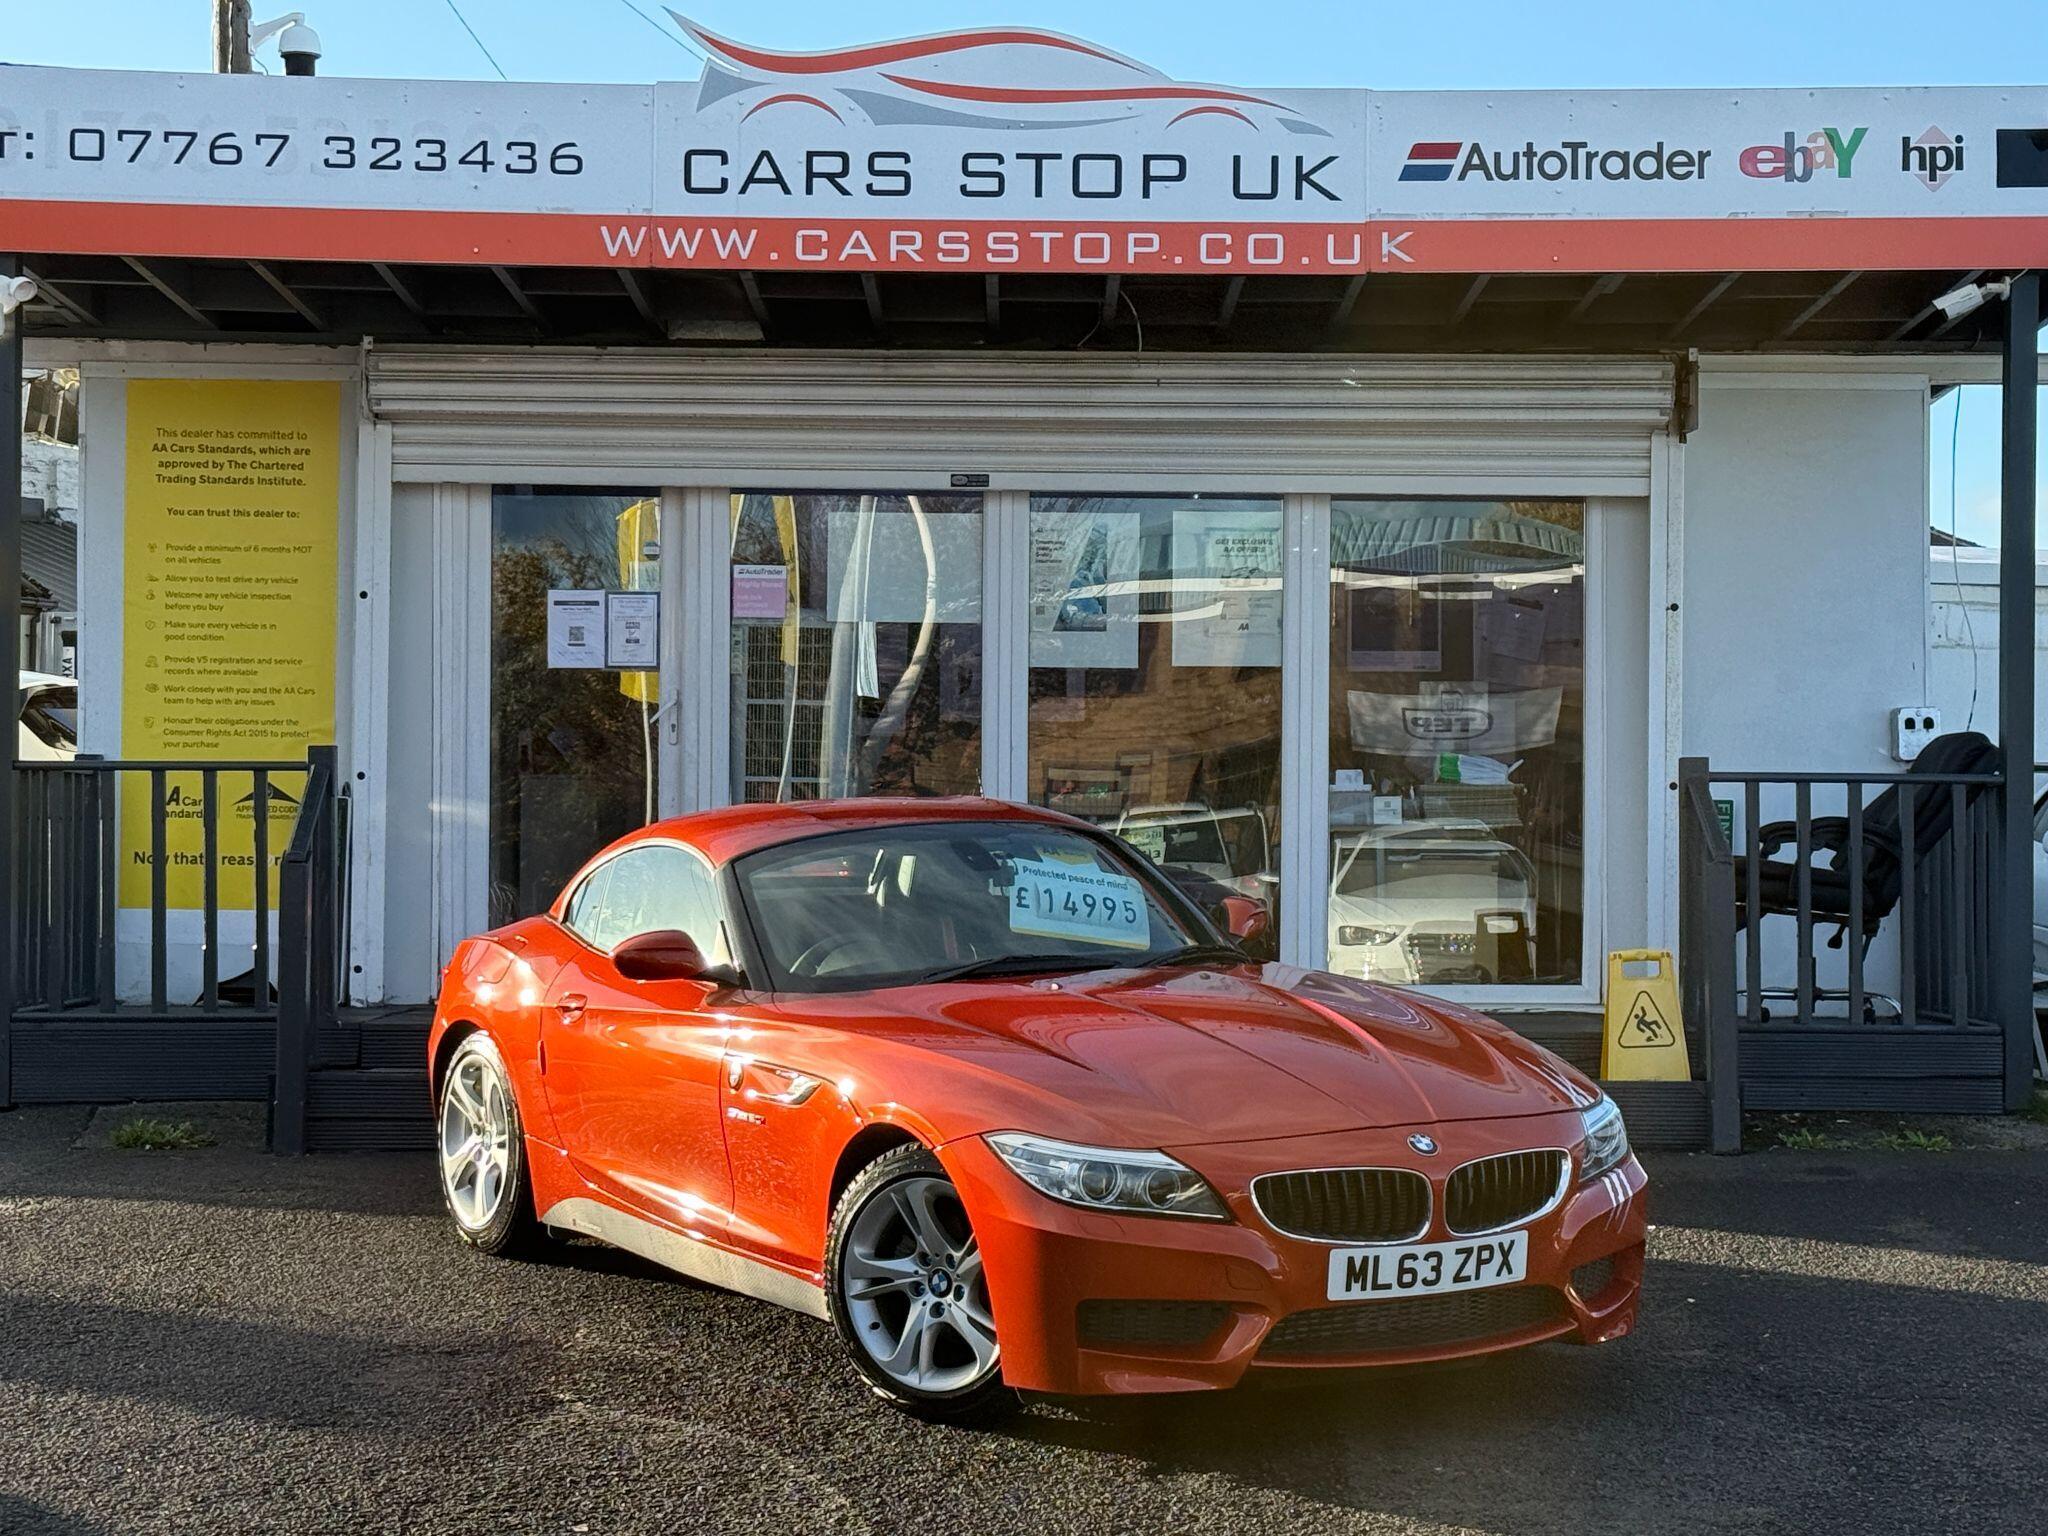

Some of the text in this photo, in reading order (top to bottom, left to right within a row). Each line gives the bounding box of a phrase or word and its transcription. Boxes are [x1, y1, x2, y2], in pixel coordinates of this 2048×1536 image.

[69, 128, 290, 167] 07767
[323, 136, 584, 175] 323436
[1457, 141, 1712, 181] AutoTrader
[1902, 135, 1964, 183] hpi
[684, 149, 1342, 201] CARS STOP UK
[600, 225, 1415, 263] WWW.CARSSTOP.CO.UK
[157, 427, 308, 440] This dealer has committed to
[152, 443, 311, 456] AA Cars Standards, which are
[158, 460, 304, 471] approved by The Chartered
[155, 474, 307, 486] Trading Standards Institute.
[167, 507, 300, 519] You can trust this dealer to:
[166, 543, 196, 552] Provide
[261, 546, 291, 554] months
[293, 546, 313, 554] MOT
[177, 556, 187, 564] all
[745, 568, 783, 576] AutoTrader
[165, 574, 188, 582] Allow
[189, 576, 204, 584] you
[254, 577, 269, 585] any
[270, 576, 299, 585] vehicle
[165, 590, 203, 599] Welcome
[220, 592, 249, 600] vehicle
[250, 593, 292, 602] inspection
[209, 604, 224, 612] buy
[164, 621, 187, 629] Make
[207, 623, 229, 631] every
[231, 622, 260, 630] vehicle
[164, 633, 185, 642] good
[165, 655, 195, 664] Provide
[210, 657, 256, 665] registration
[257, 657, 273, 665] and
[274, 657, 303, 666] service
[164, 685, 186, 693] Work
[187, 686, 215, 694] closely
[236, 687, 251, 695] you
[283, 687, 296, 695] AA
[297, 687, 316, 695] Cars
[164, 697, 185, 705] team
[215, 718, 259, 726] obligations
[261, 718, 284, 726] under
[285, 718, 299, 726] the
[163, 728, 205, 736] Consumer
[207, 728, 232, 738] Rights
[233, 729, 247, 737] Act
[249, 729, 269, 737] 2015
[281, 730, 310, 738] protect
[182, 741, 219, 749] purchase
[182, 796, 203, 806] Car
[1022, 865, 1129, 891] Protected peace of mind
[1345, 1239, 1516, 1292] ML63 ZPX
